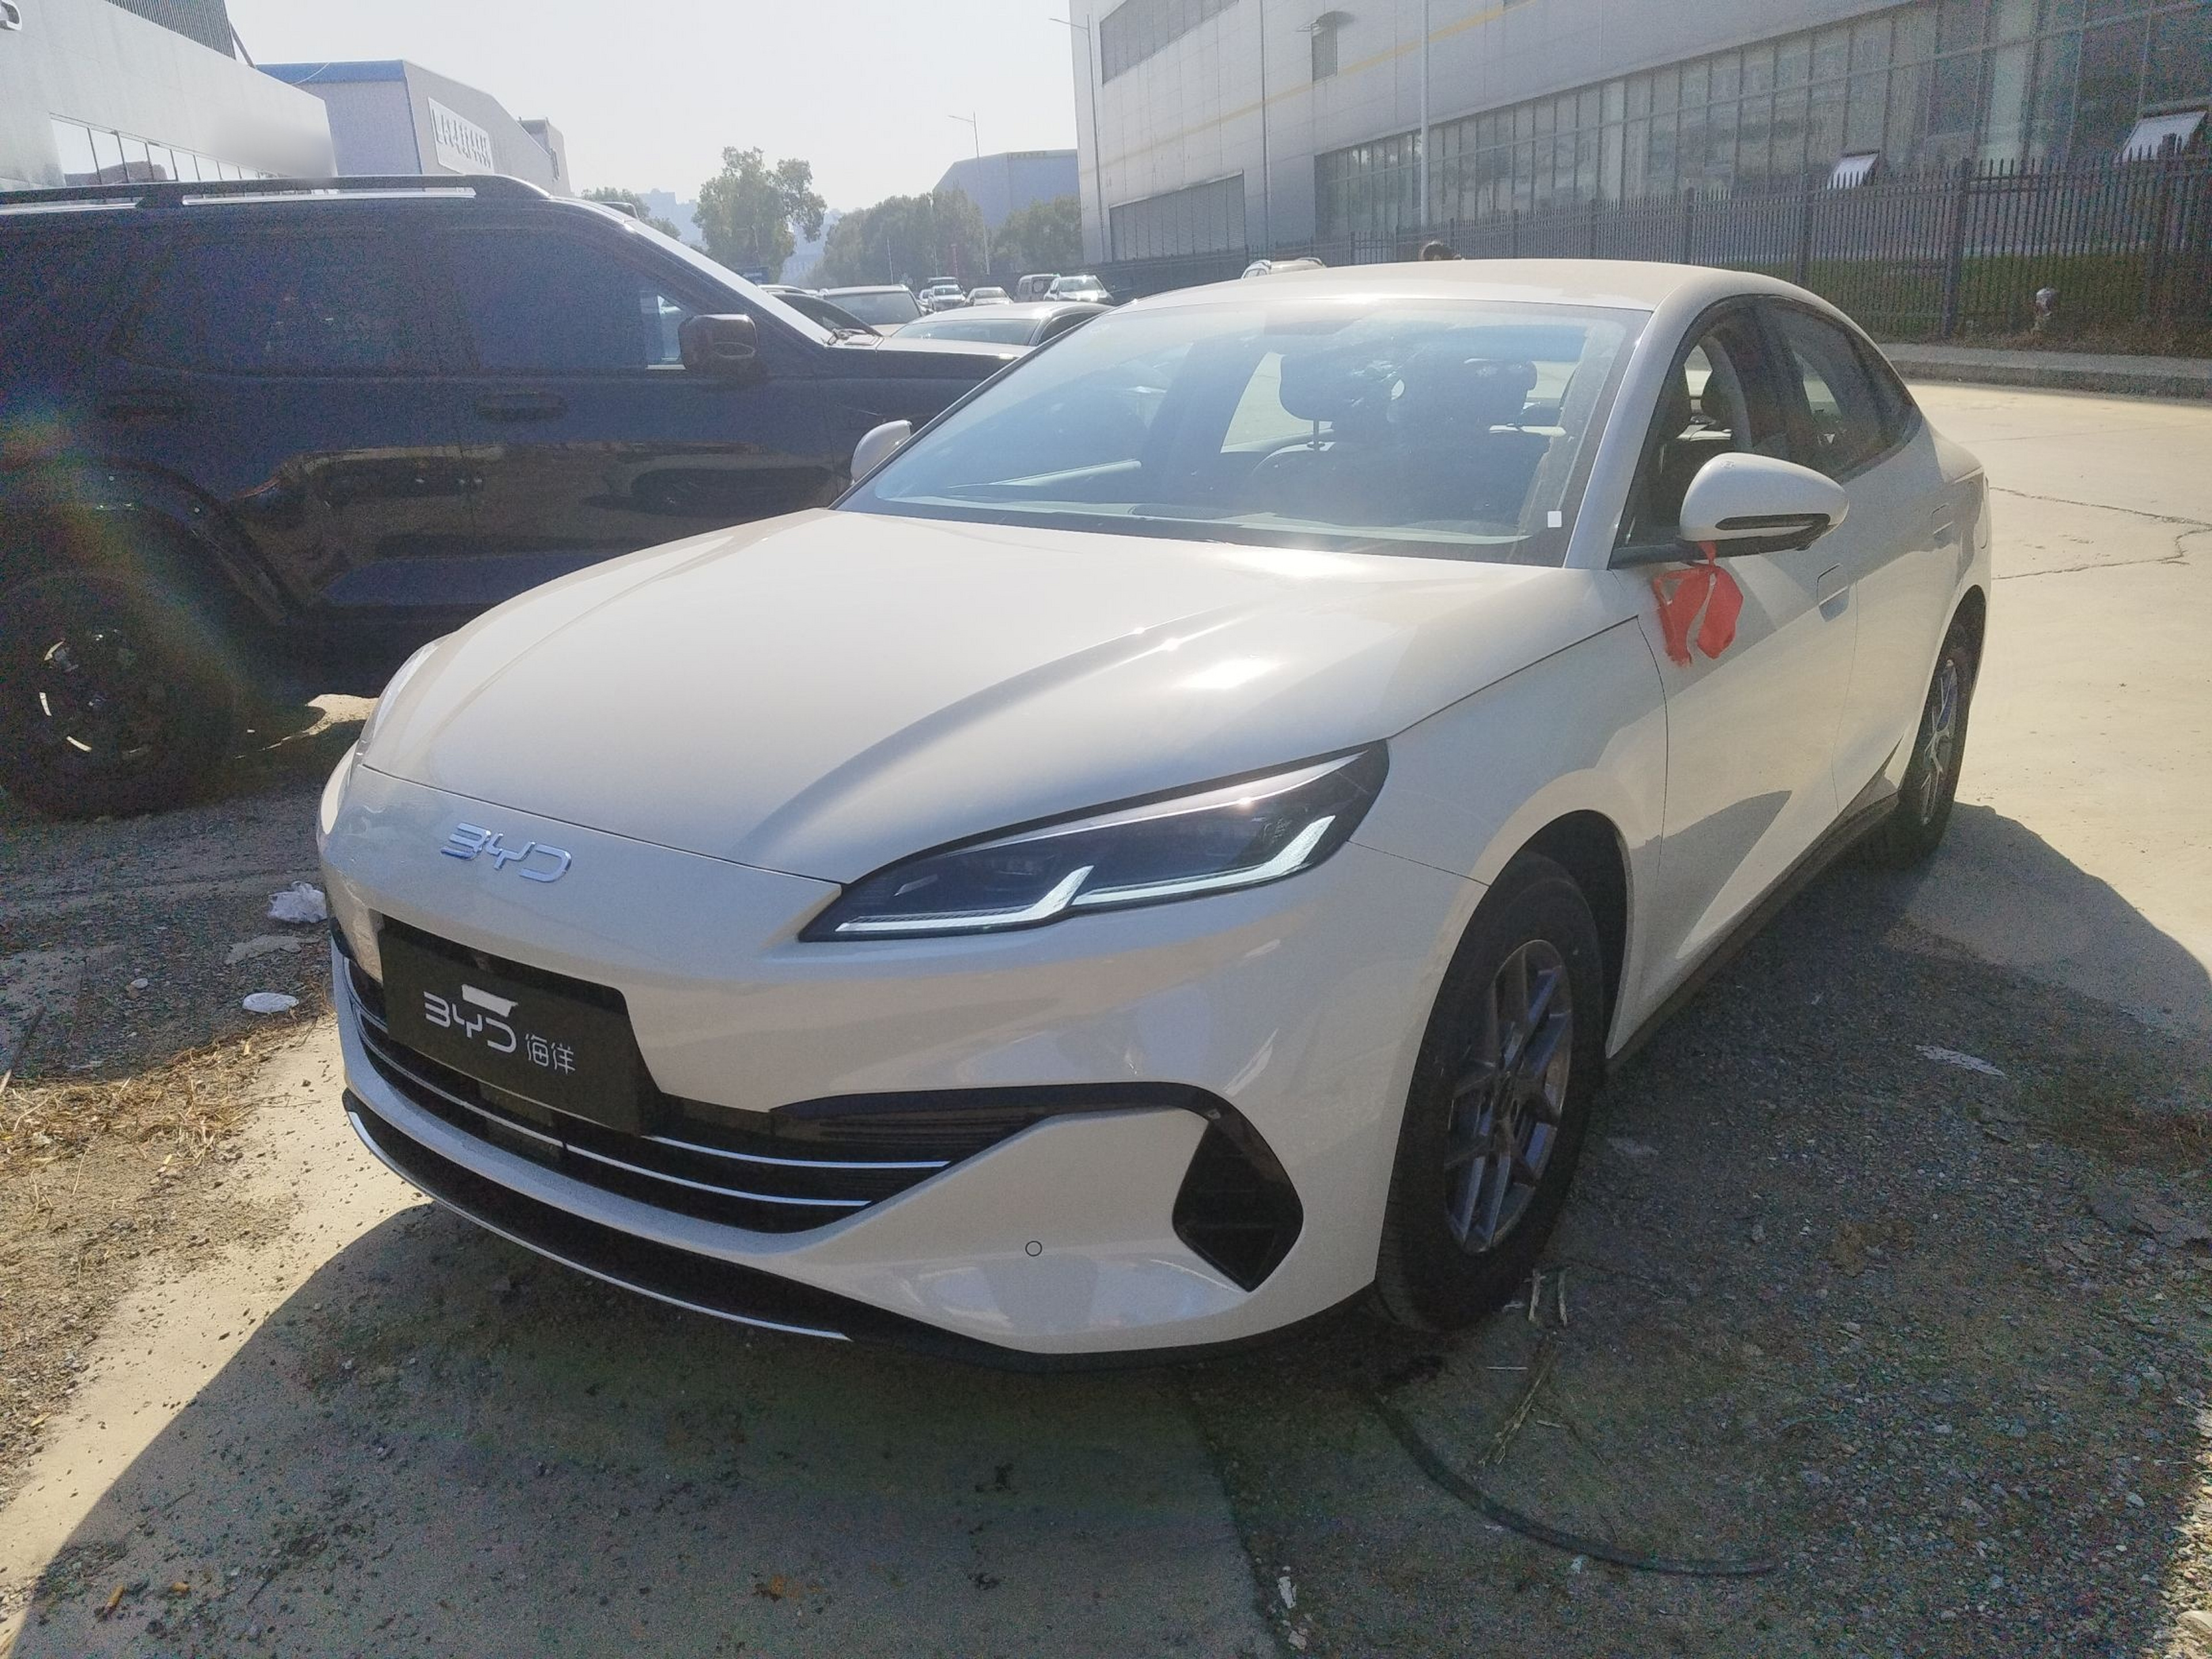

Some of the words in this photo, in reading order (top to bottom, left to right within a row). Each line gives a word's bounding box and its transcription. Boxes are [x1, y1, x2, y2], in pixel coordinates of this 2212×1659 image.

[441, 823, 572, 882] BYD
[423, 991, 517, 1053] BYD
[525, 1033, 575, 1074] 海洋
